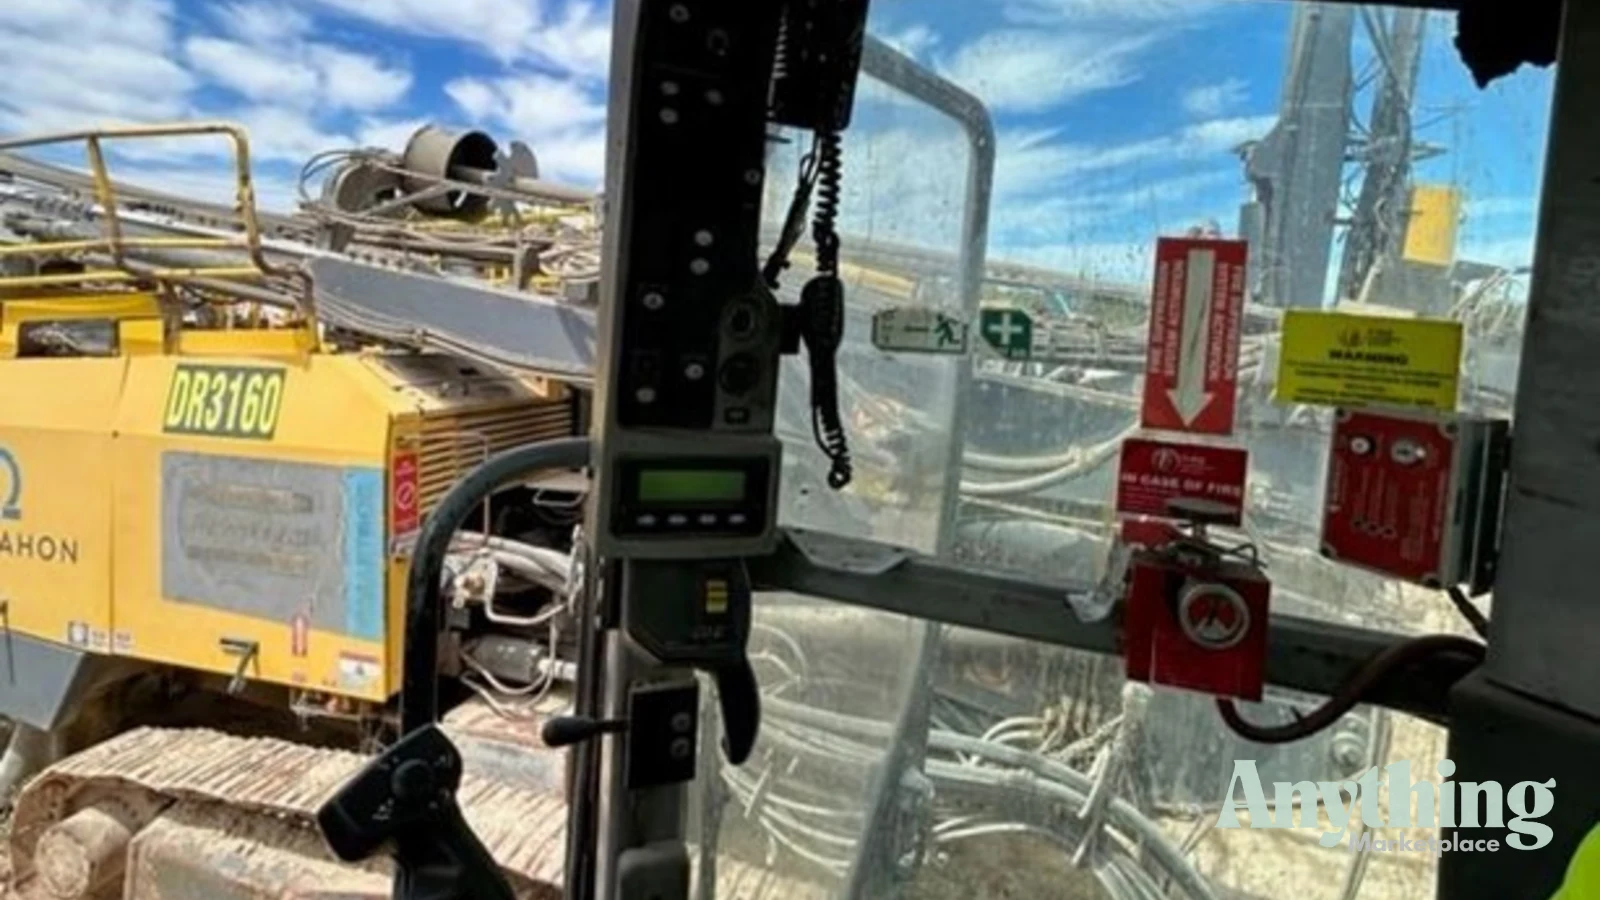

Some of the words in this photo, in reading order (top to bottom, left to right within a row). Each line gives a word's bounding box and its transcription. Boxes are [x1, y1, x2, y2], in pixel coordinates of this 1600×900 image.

[1328, 350, 1408, 365] WARNING
[166, 369, 281, 433] DR3160
[1122, 473, 1137, 483] IN
[1140, 474, 1179, 489] CASE
[1183, 481, 1203, 492] OF
[1207, 482, 1241, 497] FIRE
